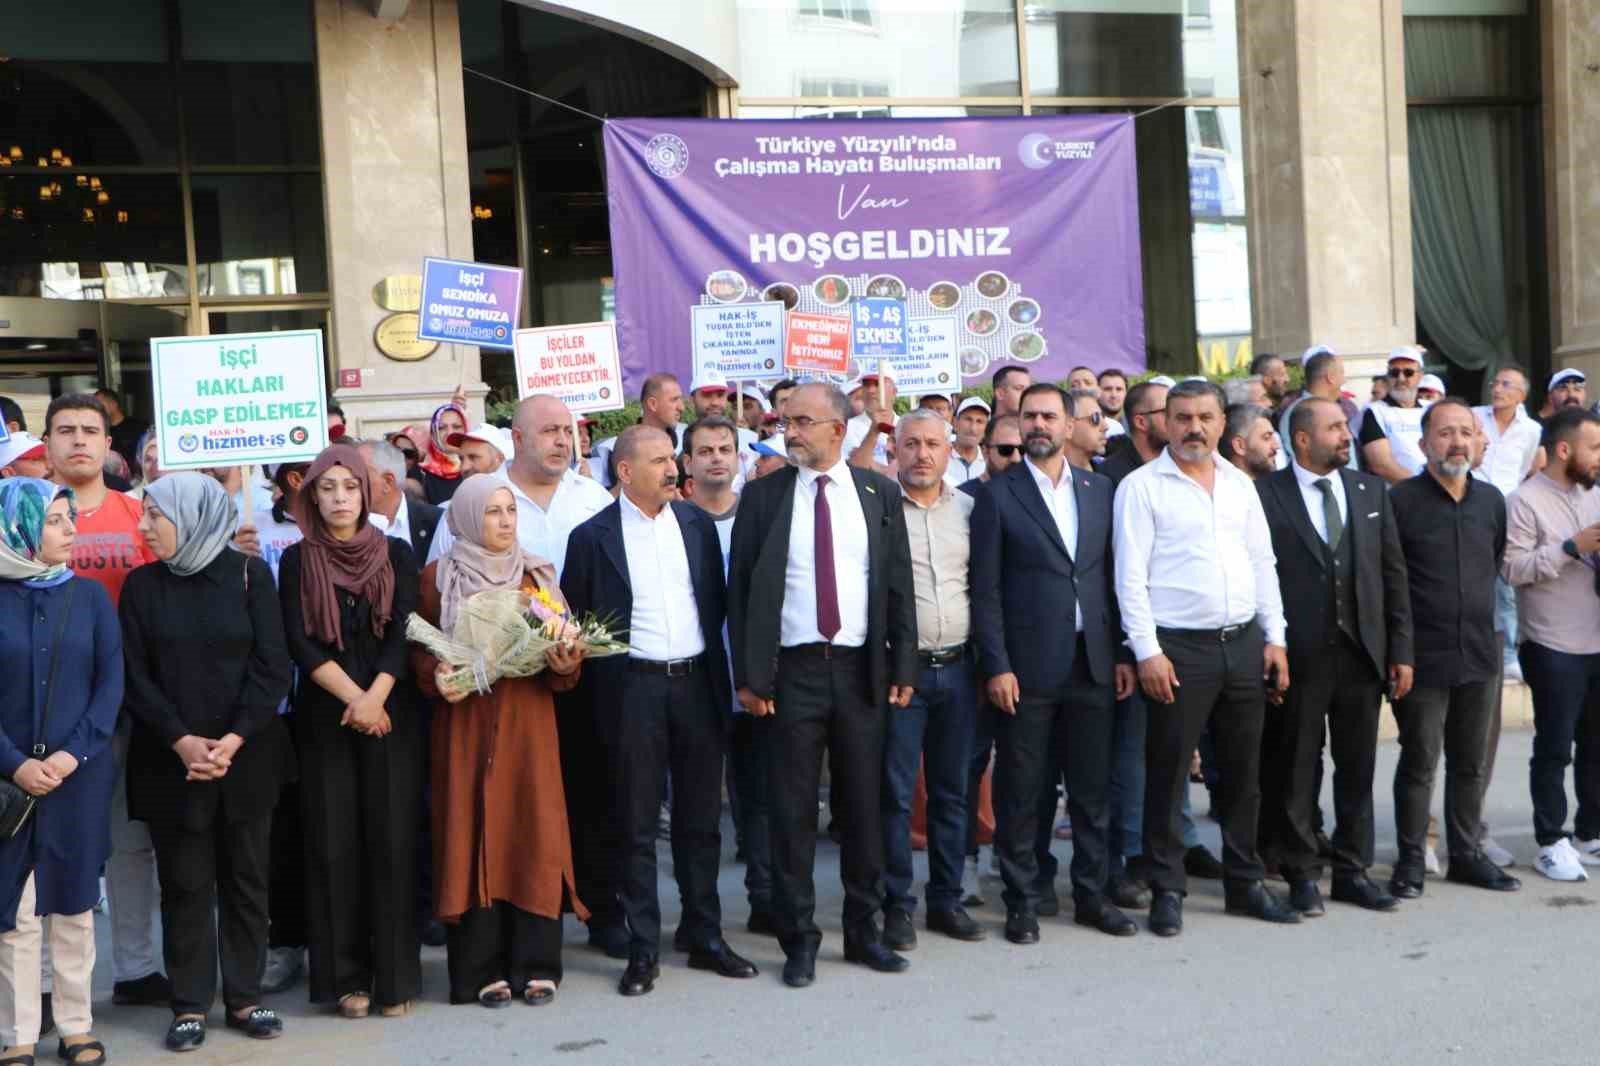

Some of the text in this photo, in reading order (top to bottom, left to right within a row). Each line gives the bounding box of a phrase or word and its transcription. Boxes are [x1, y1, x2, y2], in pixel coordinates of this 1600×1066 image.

[756, 134, 957, 156] Türkiye Yüzyılı'nda
[714, 153, 1001, 177] Çalışma Hayatı Buluşmaları
[838, 183, 909, 220] Van
[442, 288, 498, 305] SENDİKA
[429, 303, 465, 319] OMUZ
[466, 307, 509, 322] OMUZA
[856, 302, 871, 325] İŞ
[883, 304, 902, 326] AŞ
[547, 333, 585, 354] İŞÇİLER
[856, 327, 903, 344] EKMEK
[219, 343, 258, 370] İŞÇİ
[540, 351, 596, 370] BU YOLDAN
[721, 348, 758, 357] YANINDA
[196, 375, 285, 397] HAKLARI
[167, 401, 318, 427] GASP EDİLEMEZ
